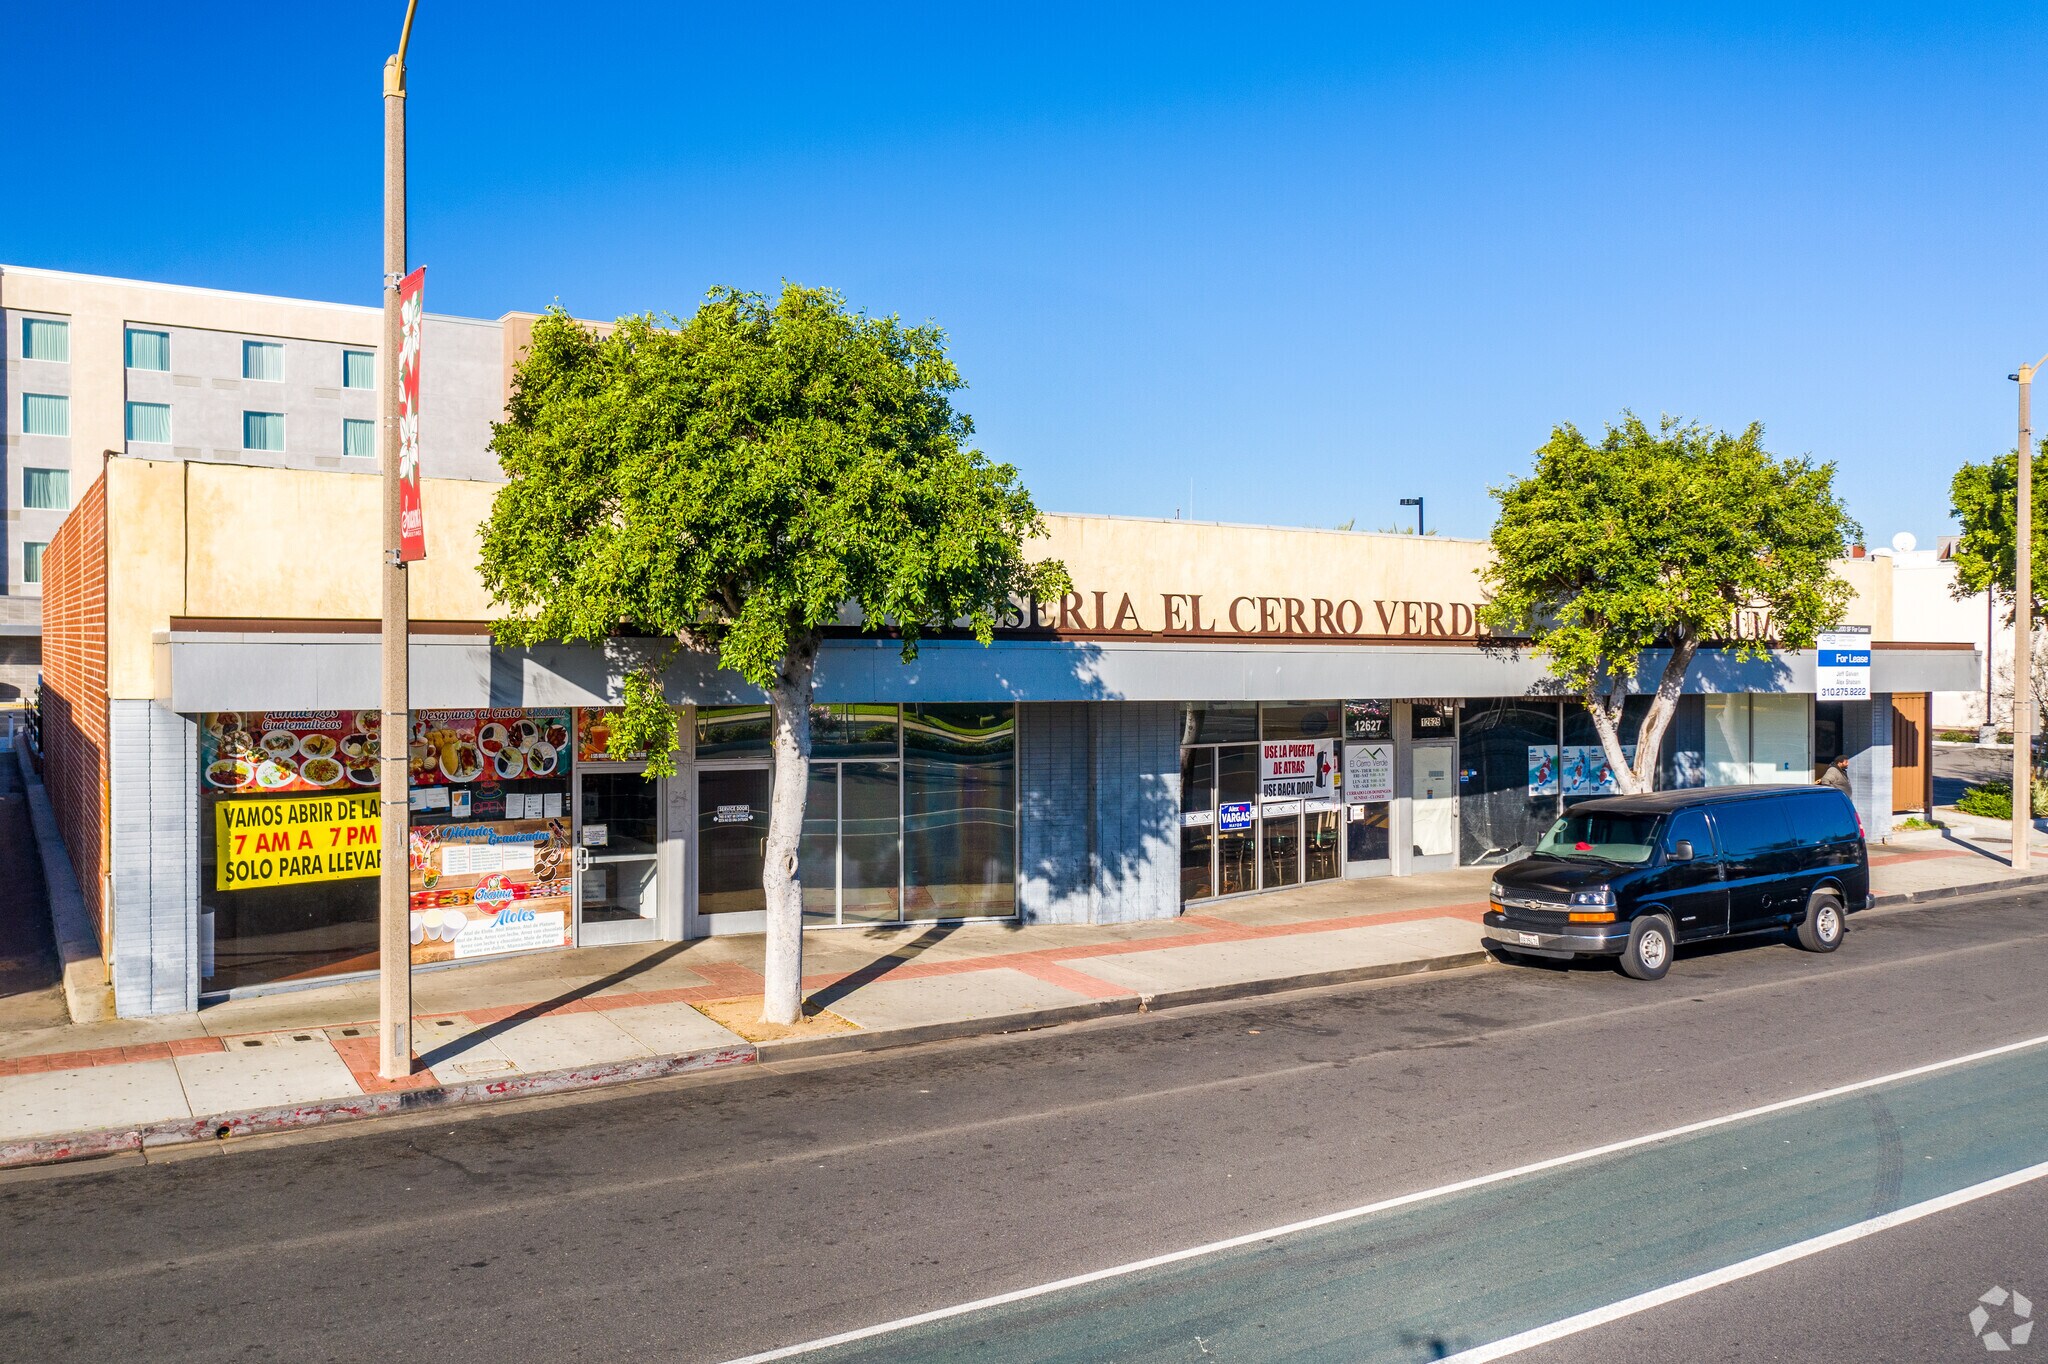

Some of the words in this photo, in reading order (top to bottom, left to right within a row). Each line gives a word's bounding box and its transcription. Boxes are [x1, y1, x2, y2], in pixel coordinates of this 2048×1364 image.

[1160, 593, 1216, 633] EL
[1228, 596, 1364, 635] CERRO
[1836, 653, 1848, 663] For
[1848, 653, 1869, 663] Lease
[1821, 687, 1867, 697] 310.275.8222
[419, 708, 476, 722] Desayunos
[478, 708, 490, 719] al
[492, 707, 522, 719] Gusto
[262, 720, 342, 730] Guatemaltecos
[1354, 720, 1382, 732] 12627
[1264, 745, 1278, 759] USE
[1279, 745, 1287, 758] LA
[1288, 744, 1315, 757] PUERTA
[1273, 761, 1283, 775] DE
[1283, 760, 1305, 774] ATRAS
[1263, 783, 1277, 797] USE
[1278, 782, 1296, 796] BACK
[1297, 781, 1314, 795] DOOR
[223, 805, 283, 829] VAMOS
[287, 802, 333, 824] ABRIR
[338, 800, 356, 820] DE
[361, 798, 381, 819] LA
[1221, 811, 1250, 824] VARGAS
[234, 834, 248, 855] 7
[255, 831, 291, 854] AM
[298, 829, 313, 850] A
[330, 826, 342, 847] 7
[347, 824, 377, 846] PM
[442, 825, 494, 840] Helados
[225, 857, 273, 883] SOLO
[279, 854, 323, 878] PARA
[490, 907, 536, 928] Atoles
